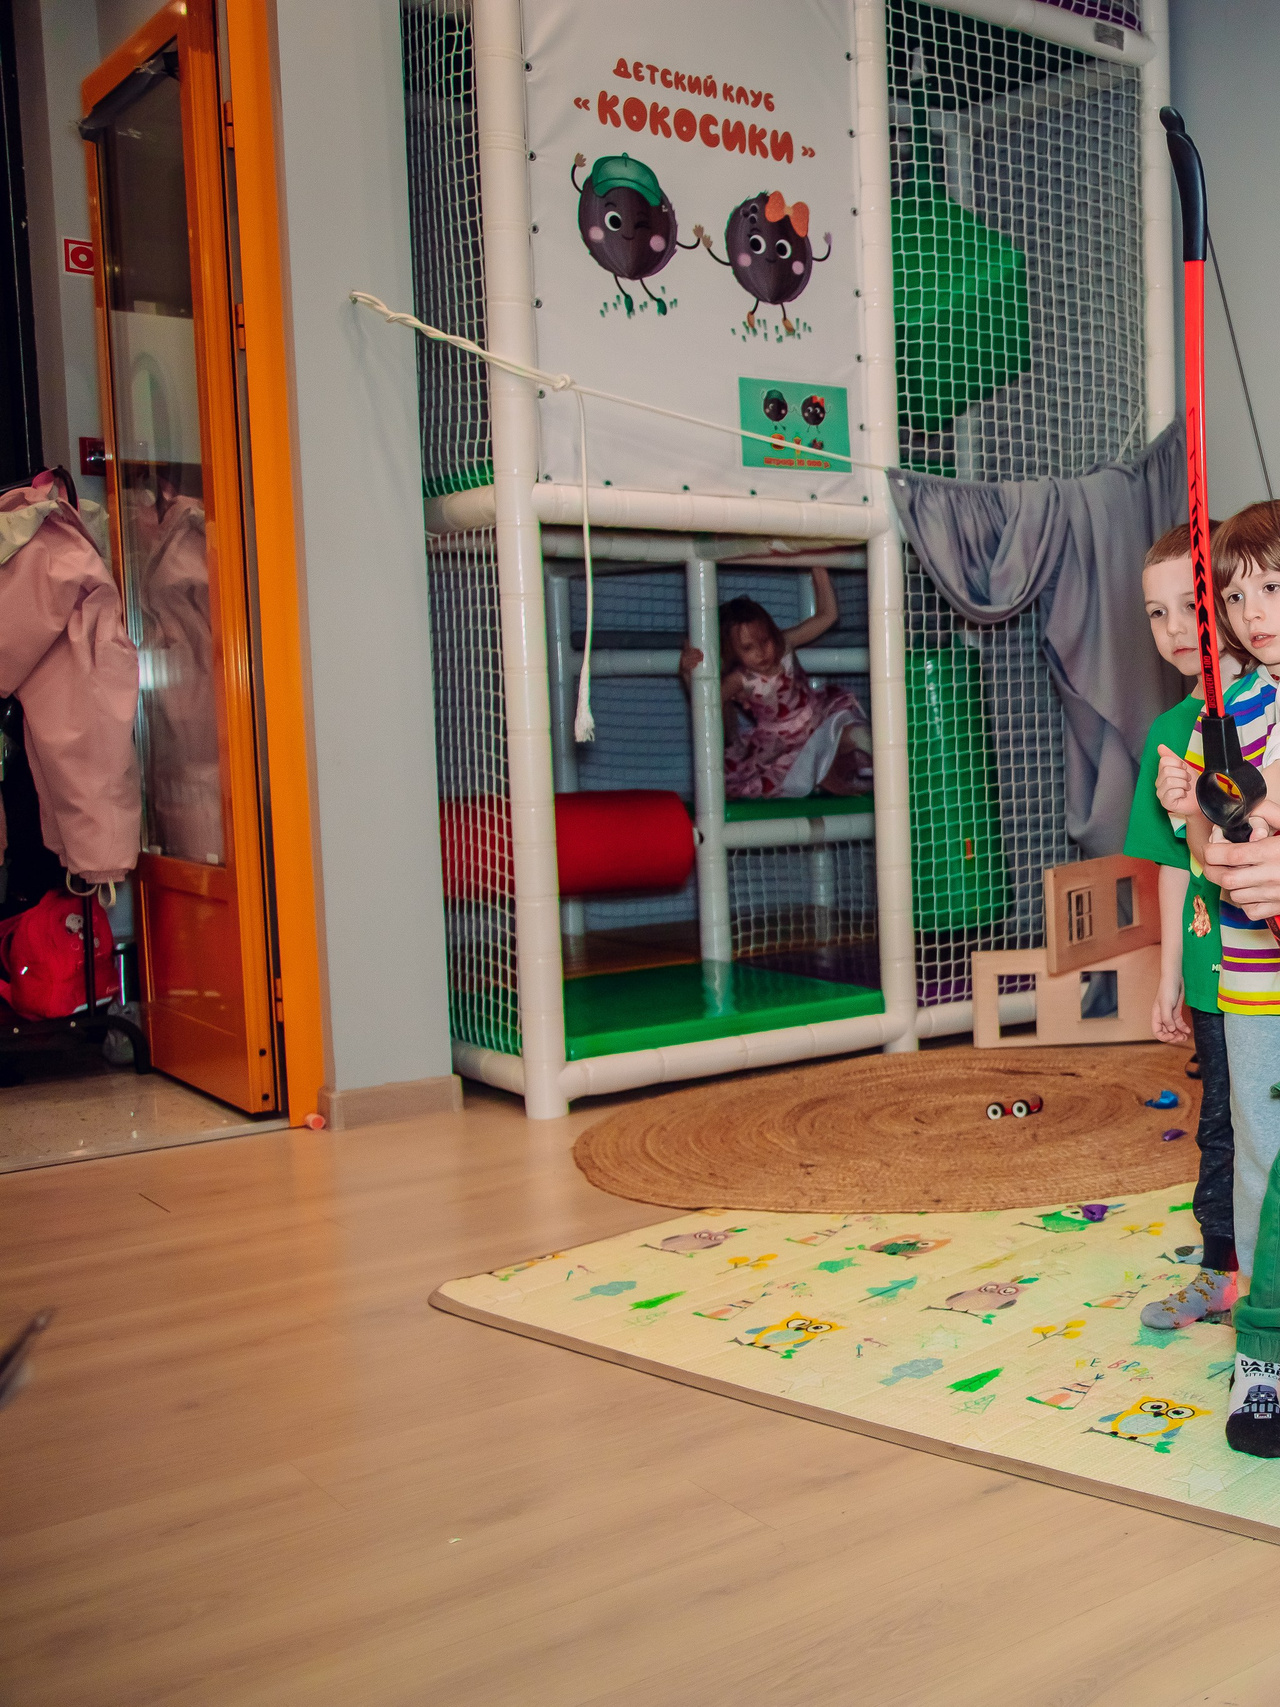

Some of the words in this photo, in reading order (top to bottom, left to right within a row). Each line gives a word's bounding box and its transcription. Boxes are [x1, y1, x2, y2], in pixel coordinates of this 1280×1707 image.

[613, 58, 717, 98] ДЕТСКИЙ
[1203, 655, 1212, 668] 100
[1205, 673, 1217, 708] DISCOVERY
